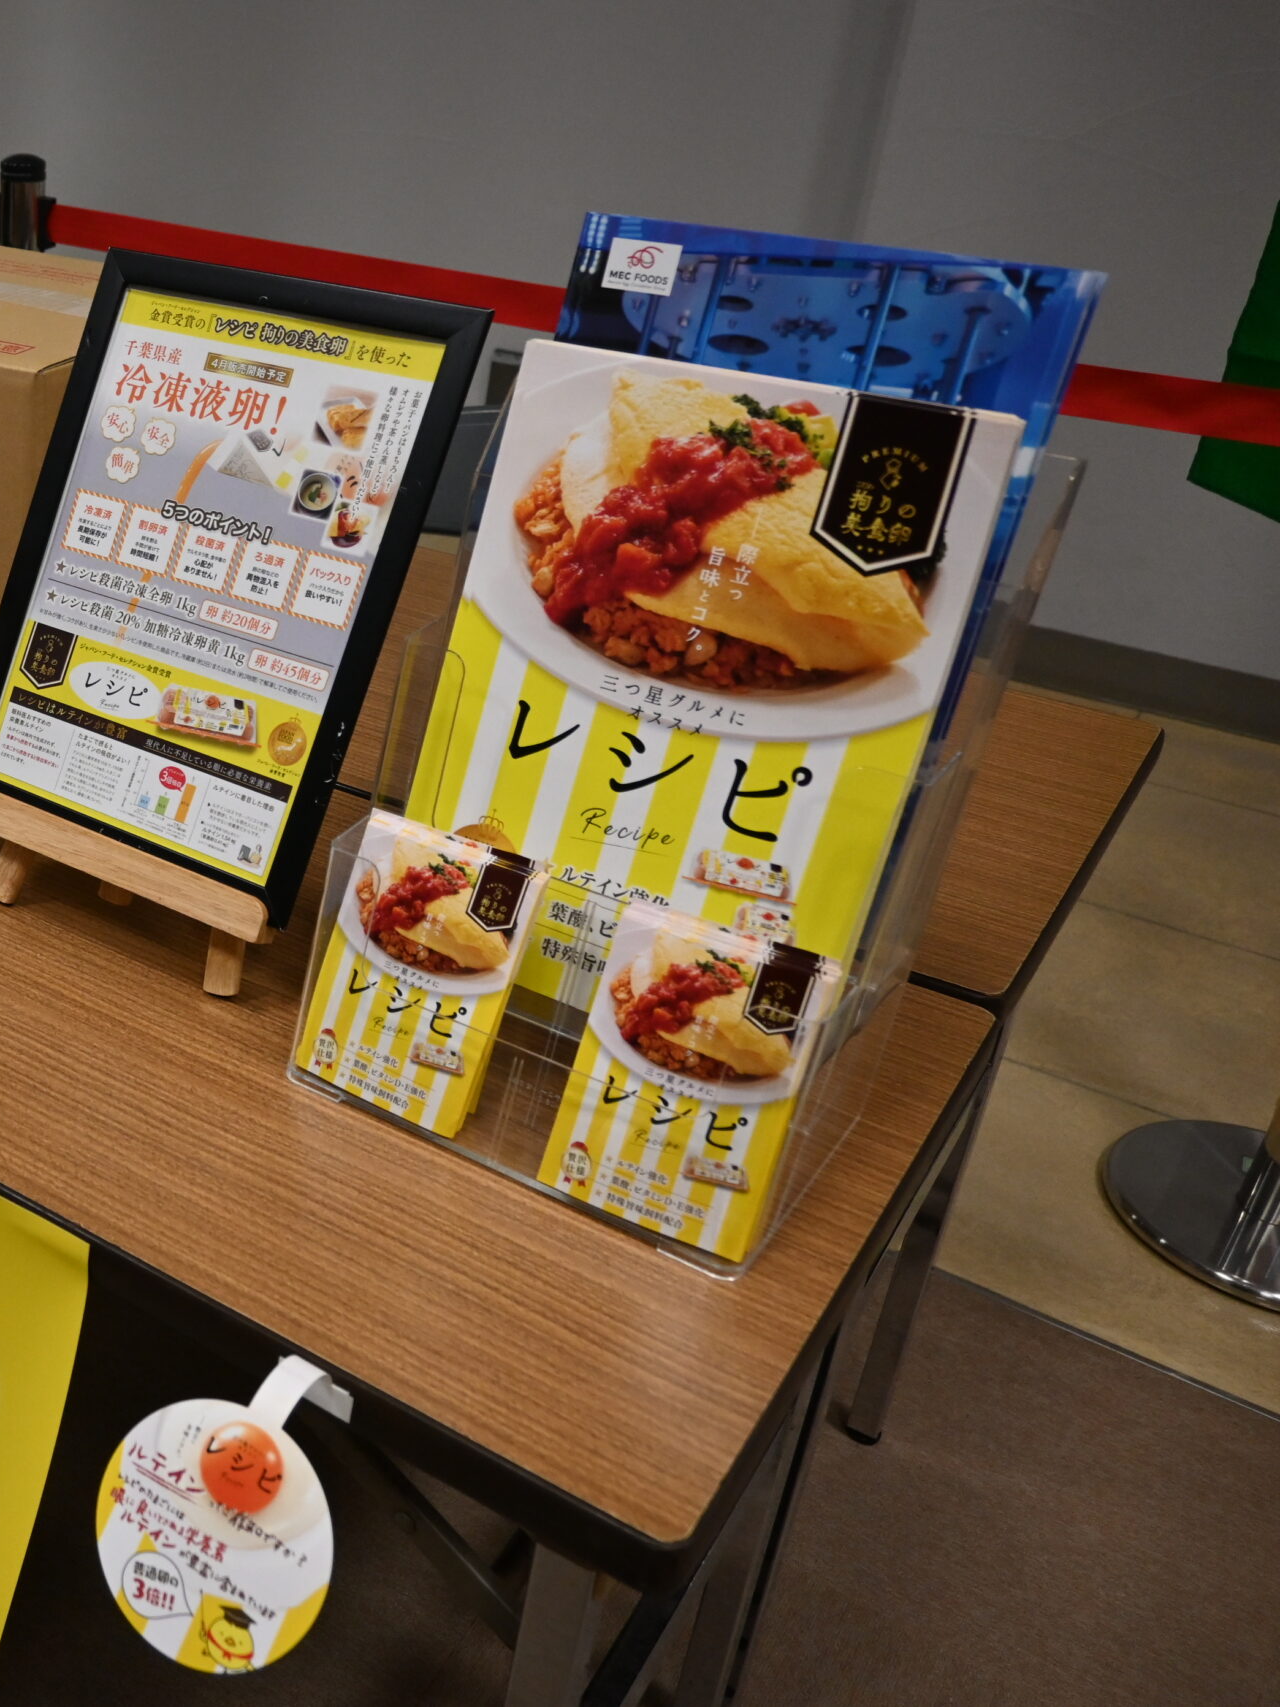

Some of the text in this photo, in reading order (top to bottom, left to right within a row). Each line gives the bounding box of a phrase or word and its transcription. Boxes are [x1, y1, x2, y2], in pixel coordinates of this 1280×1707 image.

[609, 270, 632, 281] MEC
[634, 273, 669, 286] FOODS
[124, 340, 184, 366] 千葉県産
[210, 357, 288, 384] 4月販売開始予定
[115, 362, 288, 436] 冷凍液卵！
[106, 411, 131, 436] 安心
[146, 425, 171, 450] 安全
[861, 447, 929, 474] PREMIUM
[83, 503, 114, 521] 冷凍済
[847, 488, 918, 521] 拘りの
[137, 519, 170, 537] 割卵済
[194, 534, 227, 552] 殺菌済
[253, 551, 287, 568] ろ過済
[309, 567, 352, 587] パック入り
[685, 547, 727, 654] 旨味とコク。
[84, 672, 149, 708] レシピ
[599, 672, 746, 728] 三つ星グルメに
[628, 706, 707, 738] オススメ
[507, 699, 814, 843] レシピ
[578, 806, 677, 848] Recipe
[349, 968, 468, 1039] レシピ
[357, 1045, 399, 1068] ルテイン強化
[348, 1074, 409, 1110] 特殊旨味飼料配合
[603, 1075, 749, 1151] レシピ
[616, 1160, 669, 1186] ルテイン強化
[605, 1192, 684, 1230] 特殊旨味飼料配合
[127, 1443, 206, 1494] ルテイン
[206, 1435, 283, 1494] レシピ
[132, 1561, 180, 1588] 普通卵の
